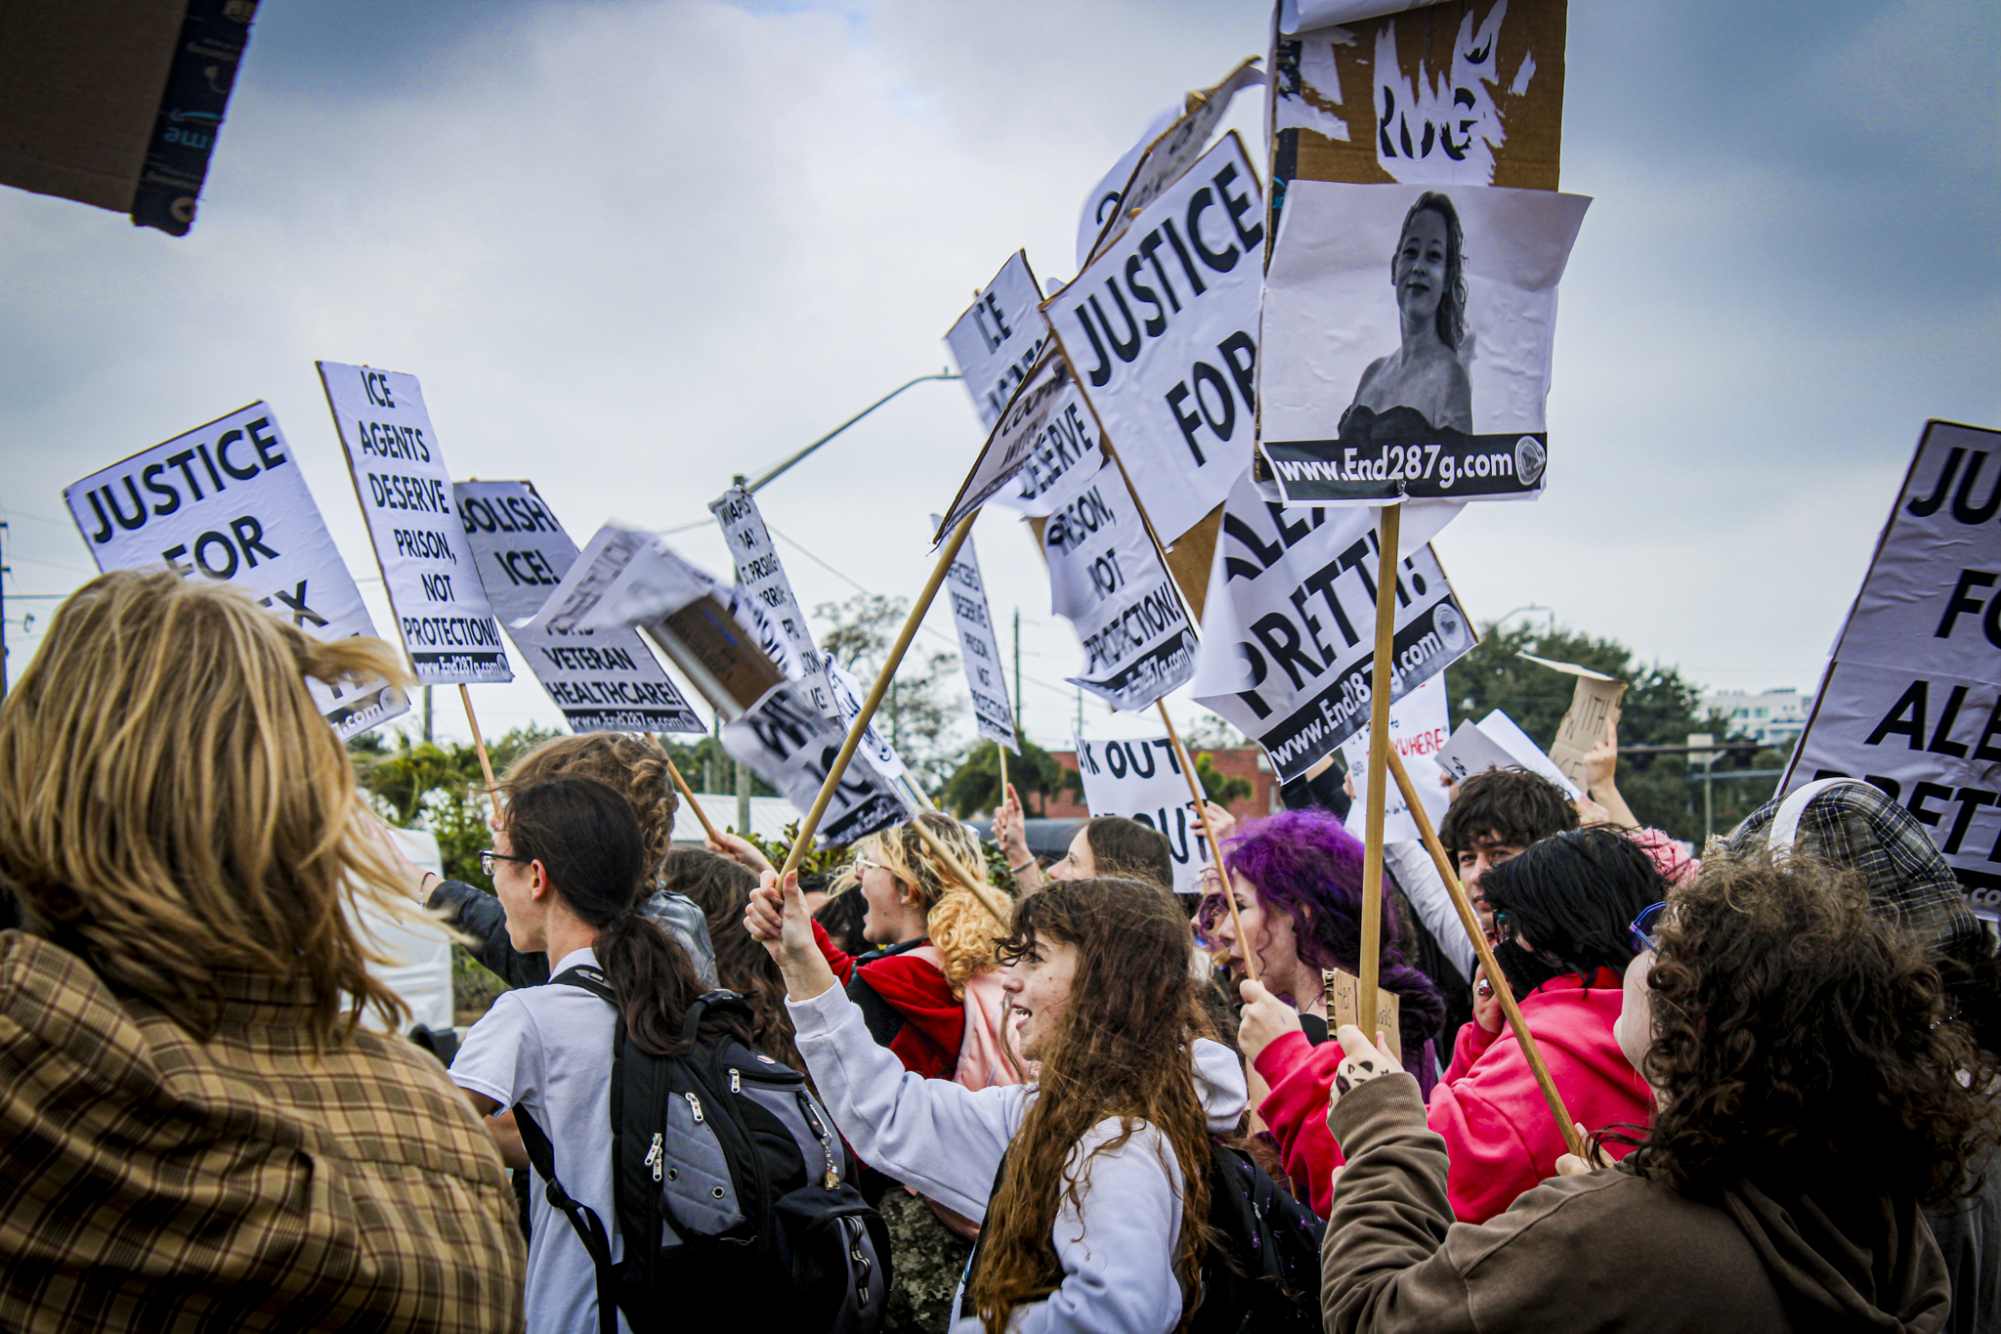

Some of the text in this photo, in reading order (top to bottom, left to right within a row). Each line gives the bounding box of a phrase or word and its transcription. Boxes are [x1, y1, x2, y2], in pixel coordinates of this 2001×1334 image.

[1074, 161, 1264, 387] JUSTICE
[360, 370, 396, 408] ICE
[1164, 330, 1257, 467] FOR
[358, 420, 430, 463] AGENTS
[85, 416, 287, 544] JUSTICE
[1275, 444, 1513, 489] www.End287g.com
[367, 472, 450, 514] DESERVE
[161, 515, 280, 580] FOR
[393, 528, 457, 566] PRISON,
[493, 549, 561, 586] ICE!
[420, 573, 455, 602] NOT
[402, 617, 500, 646] PROTECTION!
[541, 647, 637, 670] VETERAN
[545, 681, 682, 706] HEALTHCARE!
[1105, 738, 1181, 779] OUT
